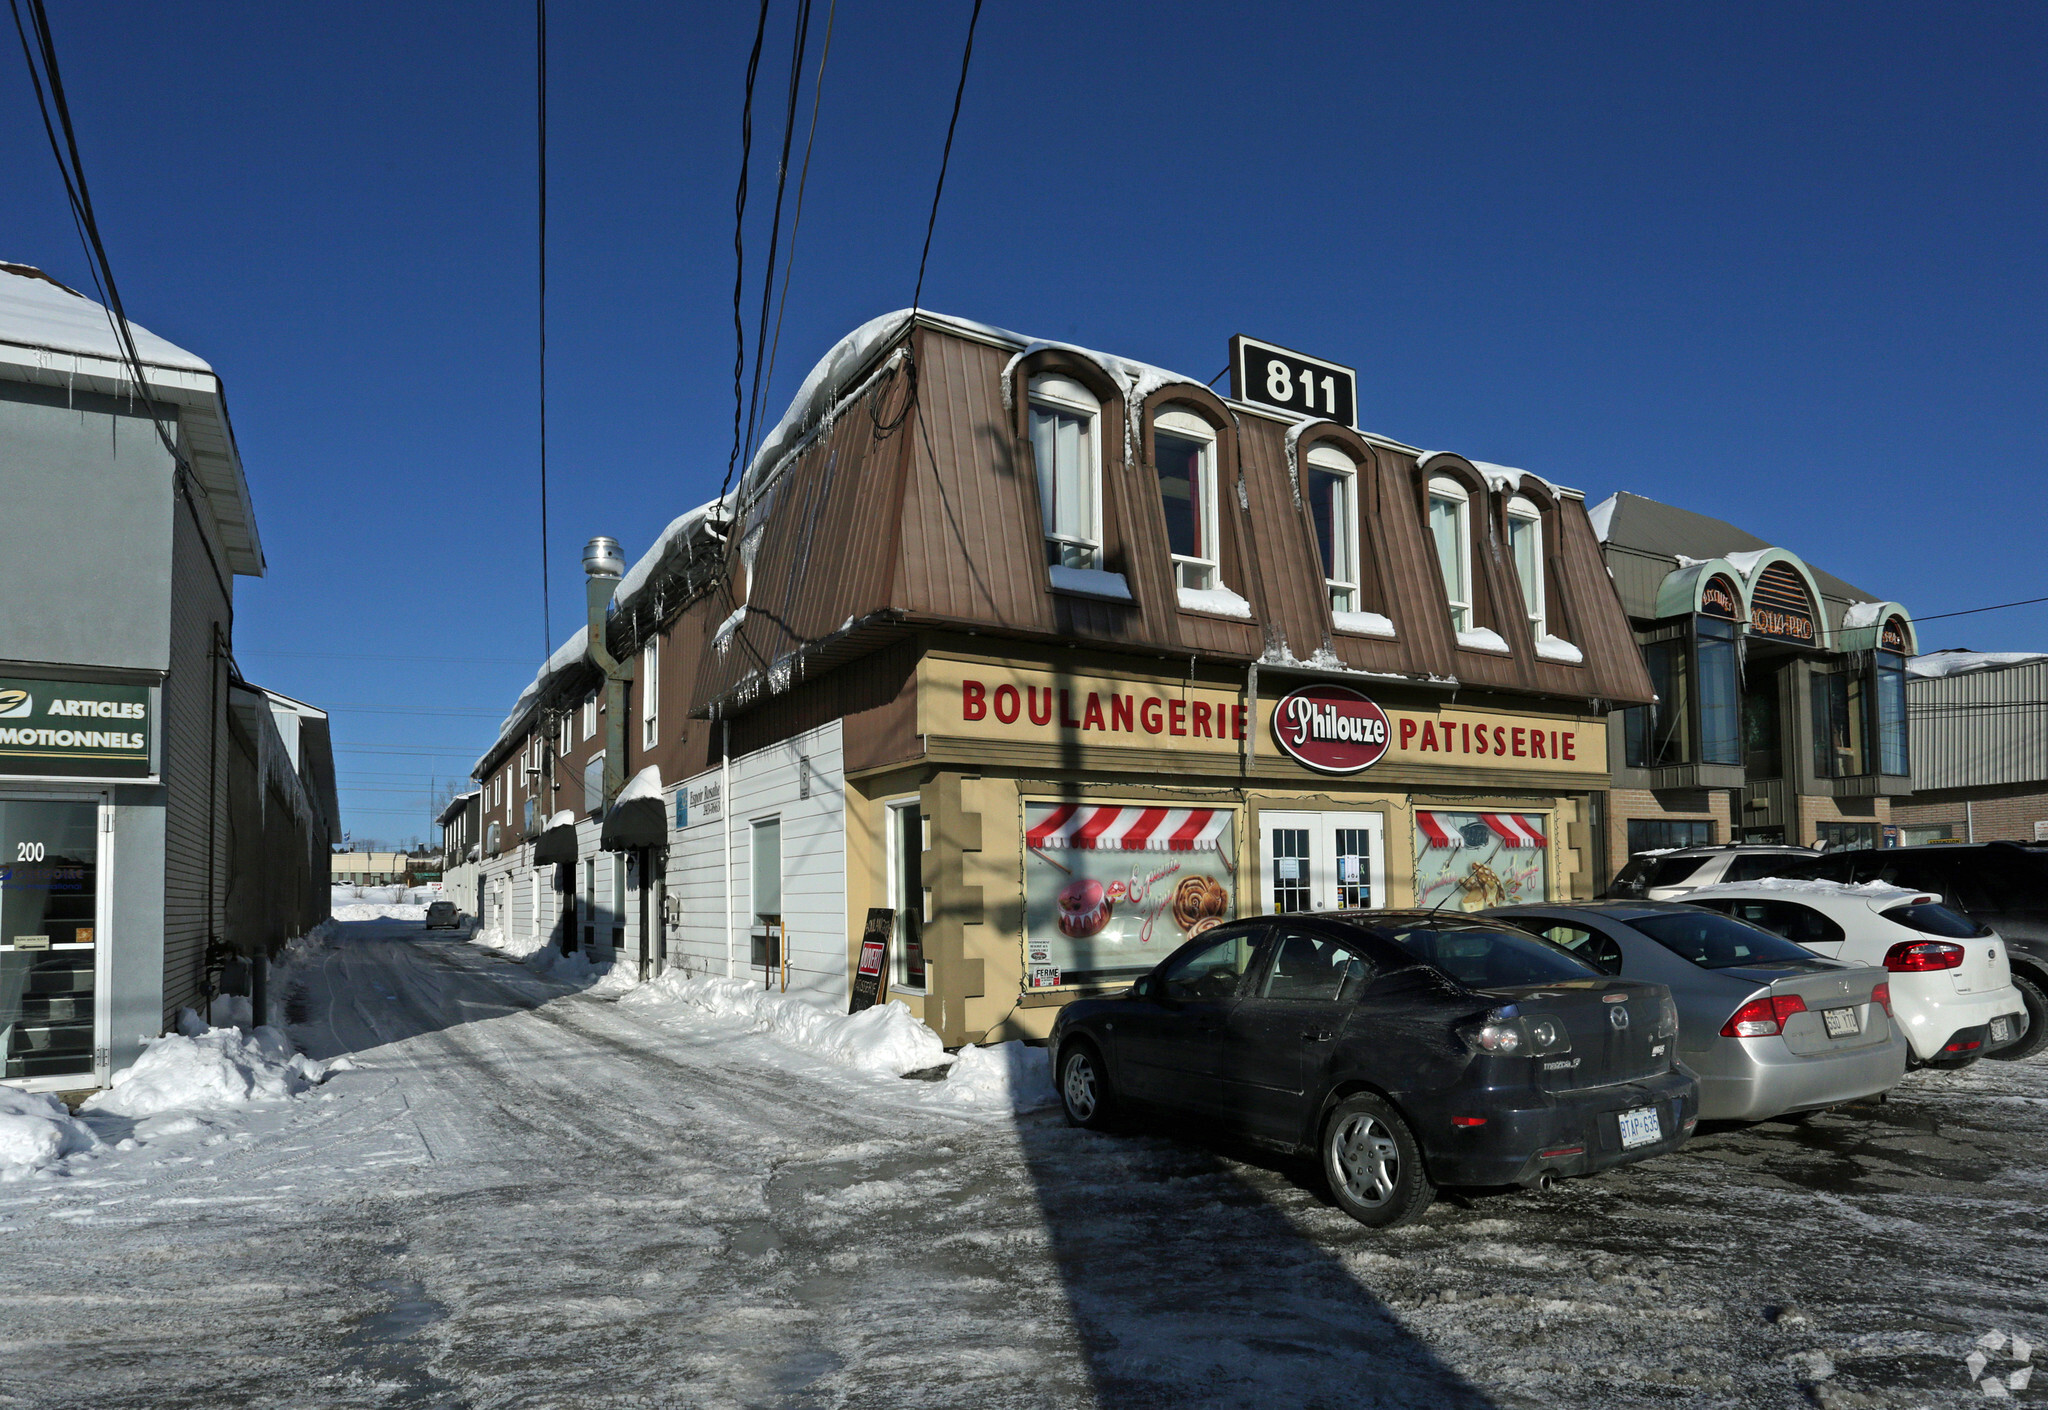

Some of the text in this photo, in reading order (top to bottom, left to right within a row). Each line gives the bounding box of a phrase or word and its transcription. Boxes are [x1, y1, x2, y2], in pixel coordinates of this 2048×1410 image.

[1266, 359, 1335, 414] 811
[47, 699, 145, 720] ARTICLES
[962, 679, 1248, 741] BOULANGERIE
[1286, 696, 1386, 745] Philouze
[0, 727, 145, 749] MOTIONNELS
[1398, 717, 1577, 762] PATISSERIE
[17, 841, 45, 863] 200
[860, 946, 883, 970] OUVERT
